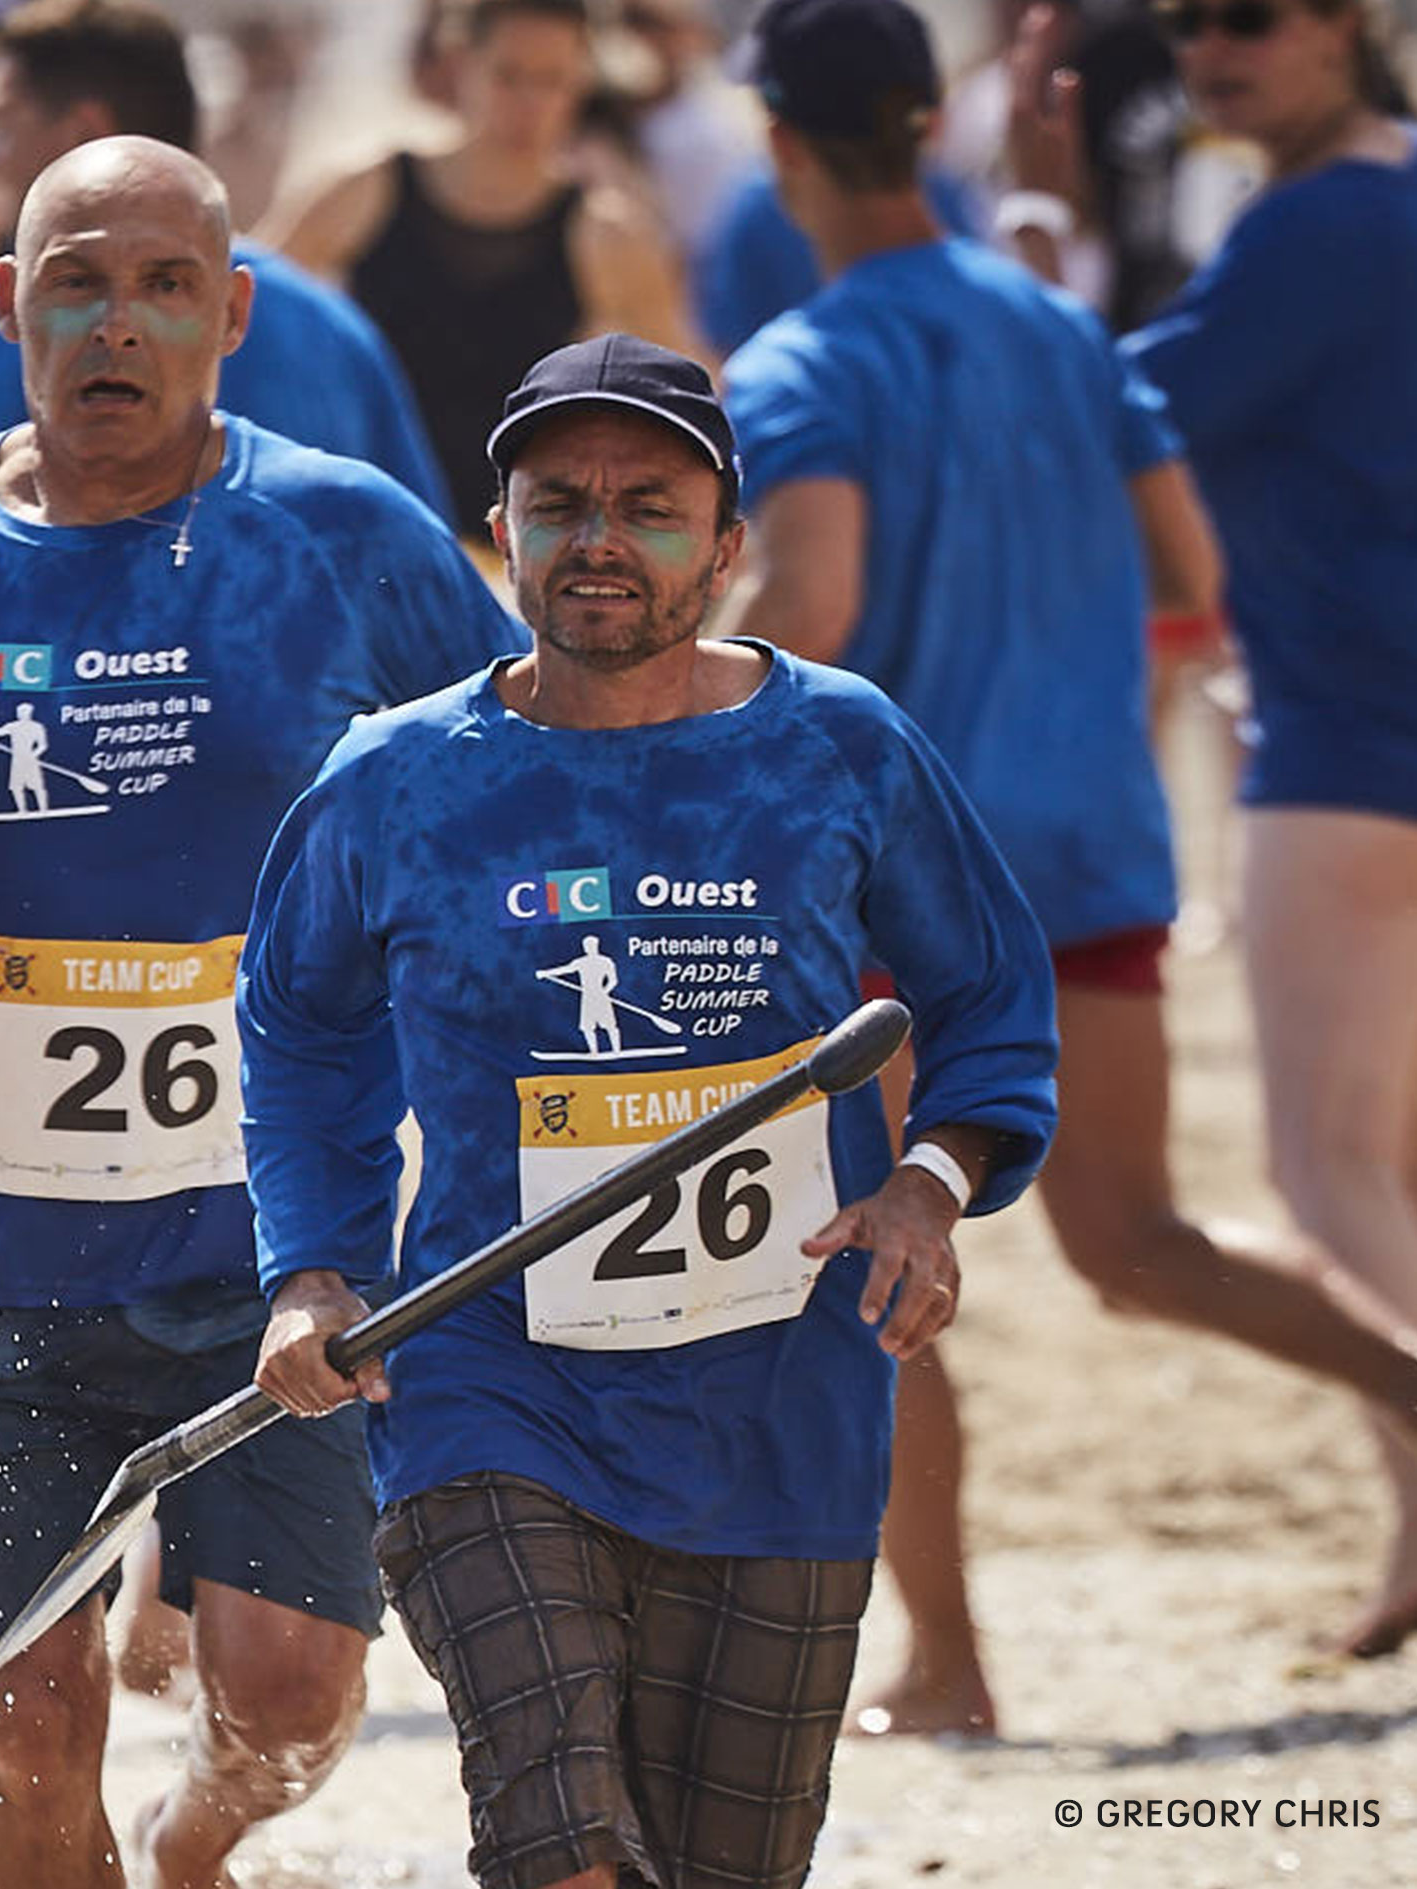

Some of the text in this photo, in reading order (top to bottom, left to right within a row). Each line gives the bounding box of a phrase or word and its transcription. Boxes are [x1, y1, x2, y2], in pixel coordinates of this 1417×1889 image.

[74, 647, 189, 680] Ouest
[61, 695, 211, 724] Partenaire de la
[94, 720, 193, 746] PADDLE
[88, 745, 196, 773] SUMMER
[118, 772, 170, 795] CUP
[506, 875, 757, 919] CIC Ouest
[628, 935, 779, 956] Partenaire de la
[62, 957, 202, 992] TEAM CUP
[664, 963, 763, 983] PADDLE
[660, 989, 769, 1011] SUMMER
[692, 1014, 742, 1036] CUP
[43, 1023, 218, 1132] 26
[604, 1089, 692, 1129] TEAM
[593, 1148, 772, 1281] 26
